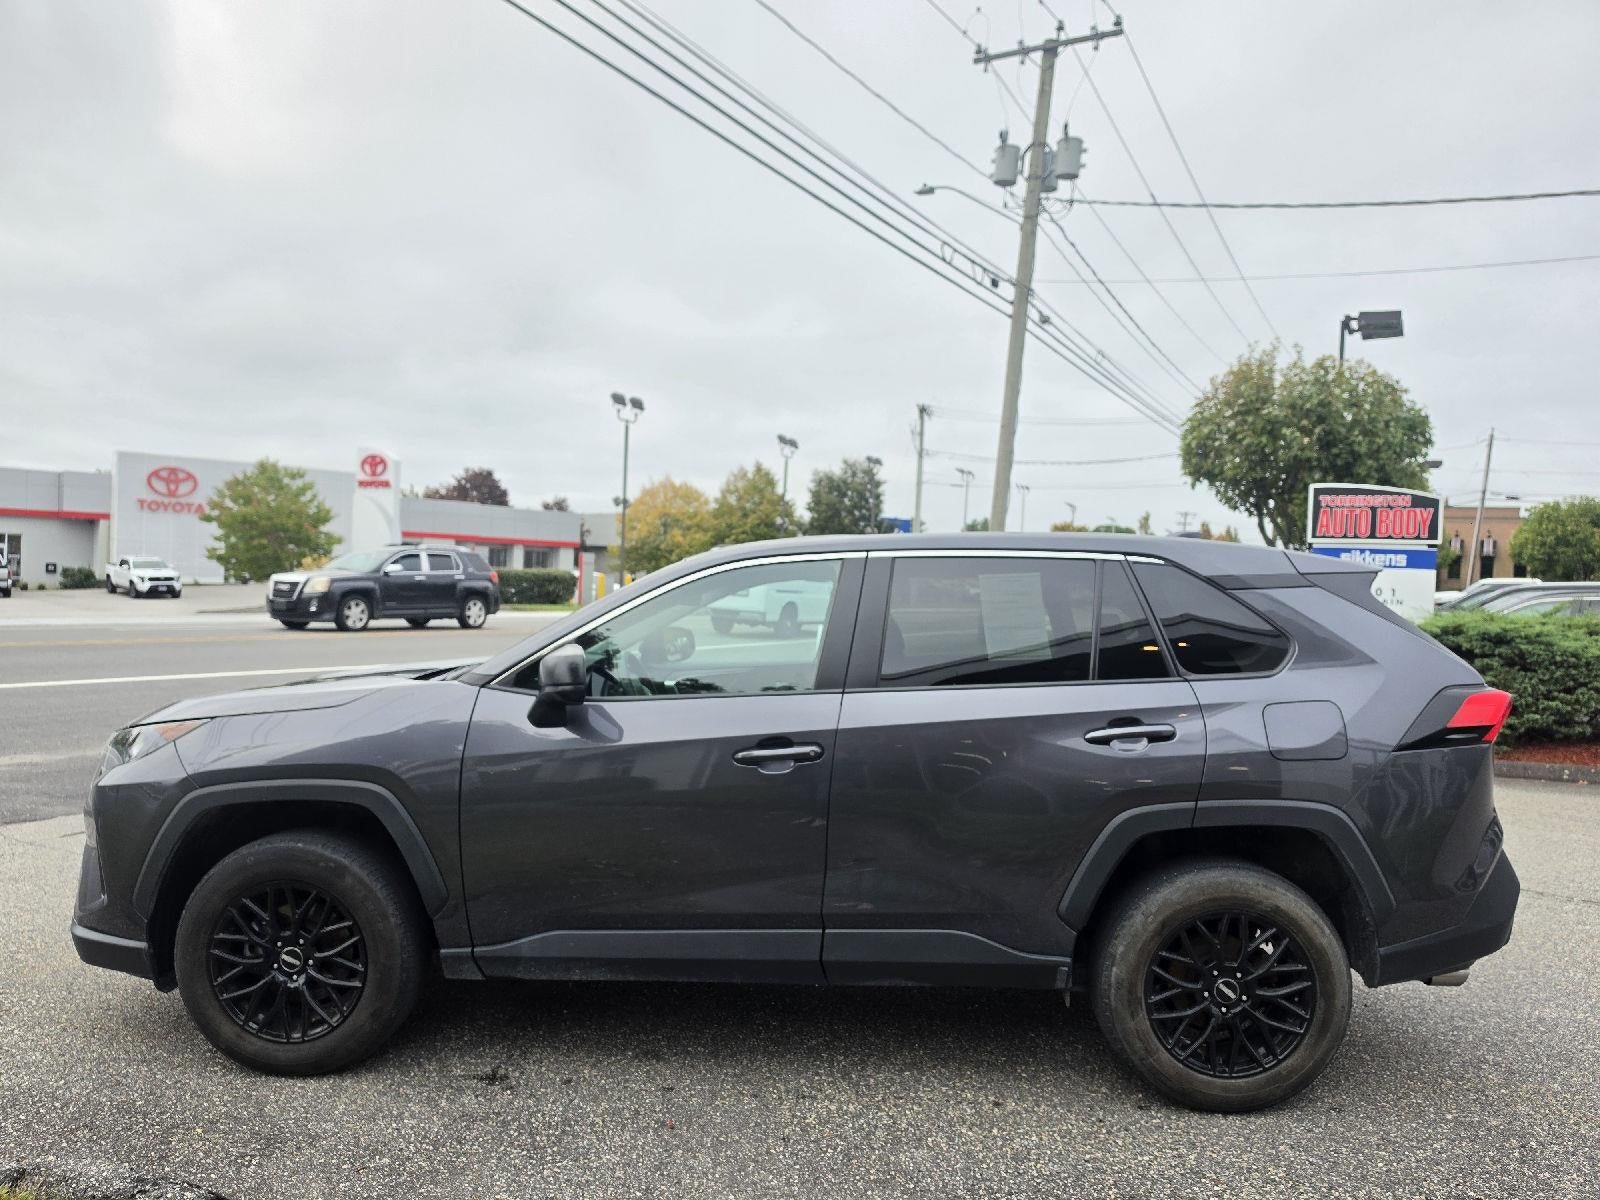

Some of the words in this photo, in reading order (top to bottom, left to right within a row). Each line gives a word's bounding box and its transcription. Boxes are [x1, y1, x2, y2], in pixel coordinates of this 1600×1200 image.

[357, 480, 391, 488] TOYOTA
[137, 498, 205, 513] TOYOTA
[1319, 495, 1412, 508] TORRINGTON
[1316, 507, 1372, 538] AUTO
[1376, 507, 1434, 539] BODY
